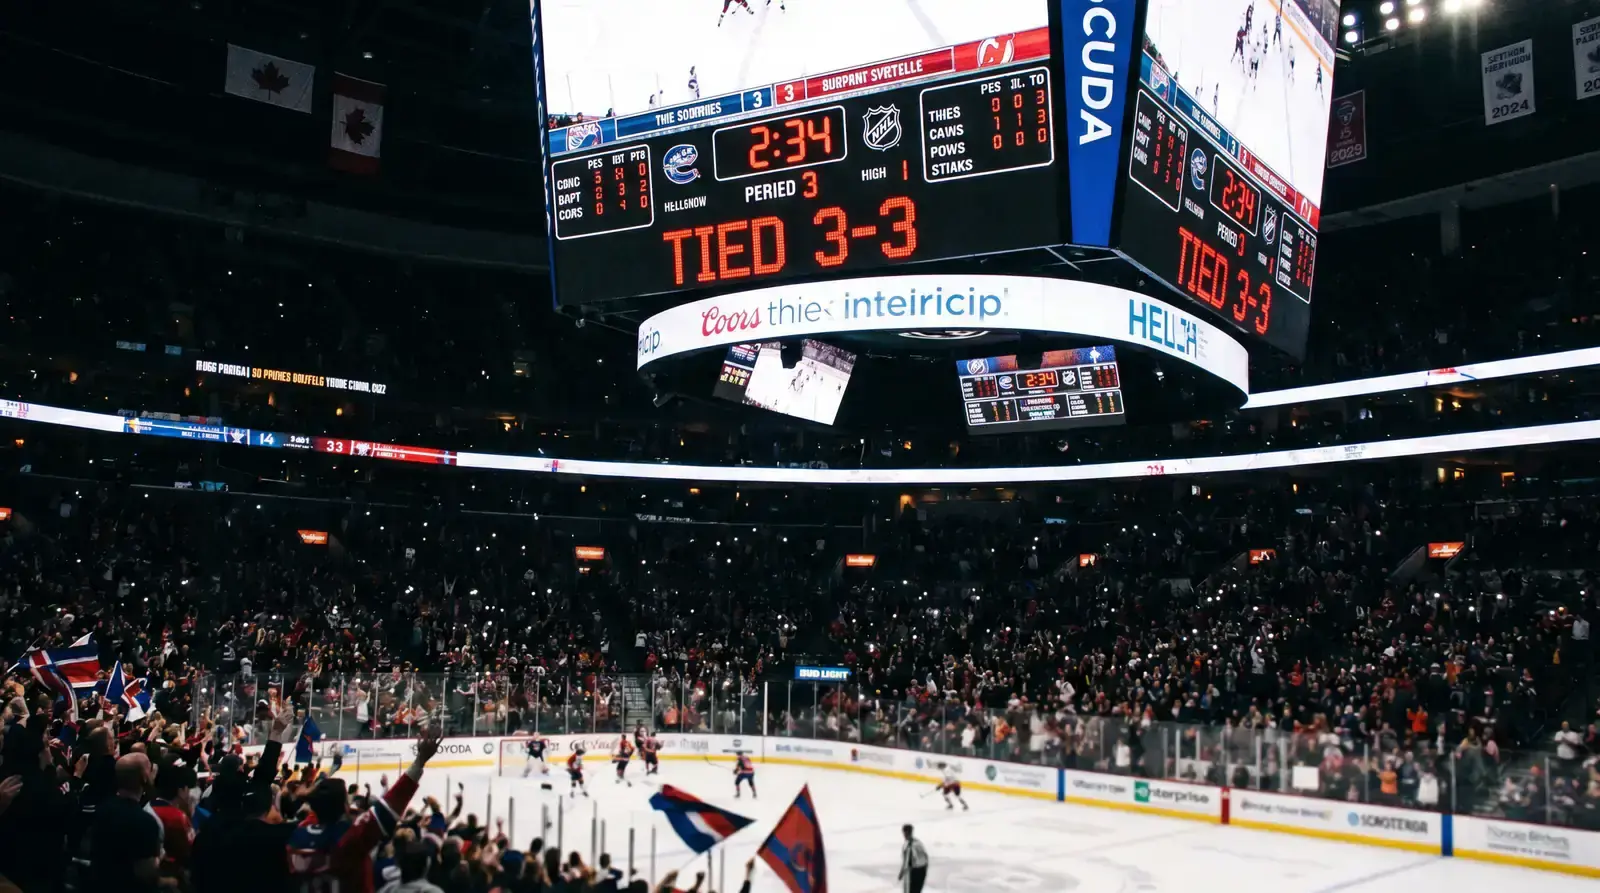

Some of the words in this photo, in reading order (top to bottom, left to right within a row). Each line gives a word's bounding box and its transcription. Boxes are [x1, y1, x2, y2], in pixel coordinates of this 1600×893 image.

[1079, 0, 1117, 146] CUDA
[784, 84, 794, 101] 3
[981, 81, 1001, 95] PES
[1029, 73, 1045, 86] TO
[753, 91, 763, 108] 3
[928, 106, 961, 124] THIES
[1014, 93, 1023, 109] 0
[1036, 89, 1046, 105] 3
[1492, 99, 1529, 119] 2024
[872, 116, 894, 143] NHL
[929, 124, 964, 141] CAWS
[1017, 112, 1022, 127] 1
[1037, 108, 1047, 124] 3
[750, 115, 832, 169] 2:34
[930, 142, 966, 158] POWS
[993, 134, 1003, 150] 0
[1015, 131, 1025, 147] 0
[1038, 127, 1048, 143] 0
[1231, 140, 1237, 156] 3
[588, 158, 603, 170] PES
[1242, 149, 1248, 165] 3
[1330, 144, 1363, 163] 2029
[638, 162, 647, 176] 0
[861, 166, 887, 181] HIGH
[931, 158, 974, 177] STIAKS
[558, 191, 582, 206] BAPT
[619, 182, 626, 196] 3
[640, 179, 647, 192] 2
[745, 179, 796, 203] PERIED
[802, 171, 818, 199] 3
[1222, 169, 1255, 225] 2:34
[559, 207, 583, 220] CORS
[640, 195, 648, 208] 0
[663, 215, 786, 285] TIED
[813, 195, 918, 269] 3-3
[1238, 232, 1246, 257] 3
[1177, 225, 1229, 310] TIED
[1231, 268, 1272, 336] 3-3
[701, 306, 762, 337] Coors
[1025, 371, 1056, 388] 2:34
[259, 432, 275, 446] 14
[326, 440, 344, 453] 33
[799, 669, 820, 678] BUD
[821, 669, 849, 680] LIGHT
[436, 743, 473, 755] OYODA
